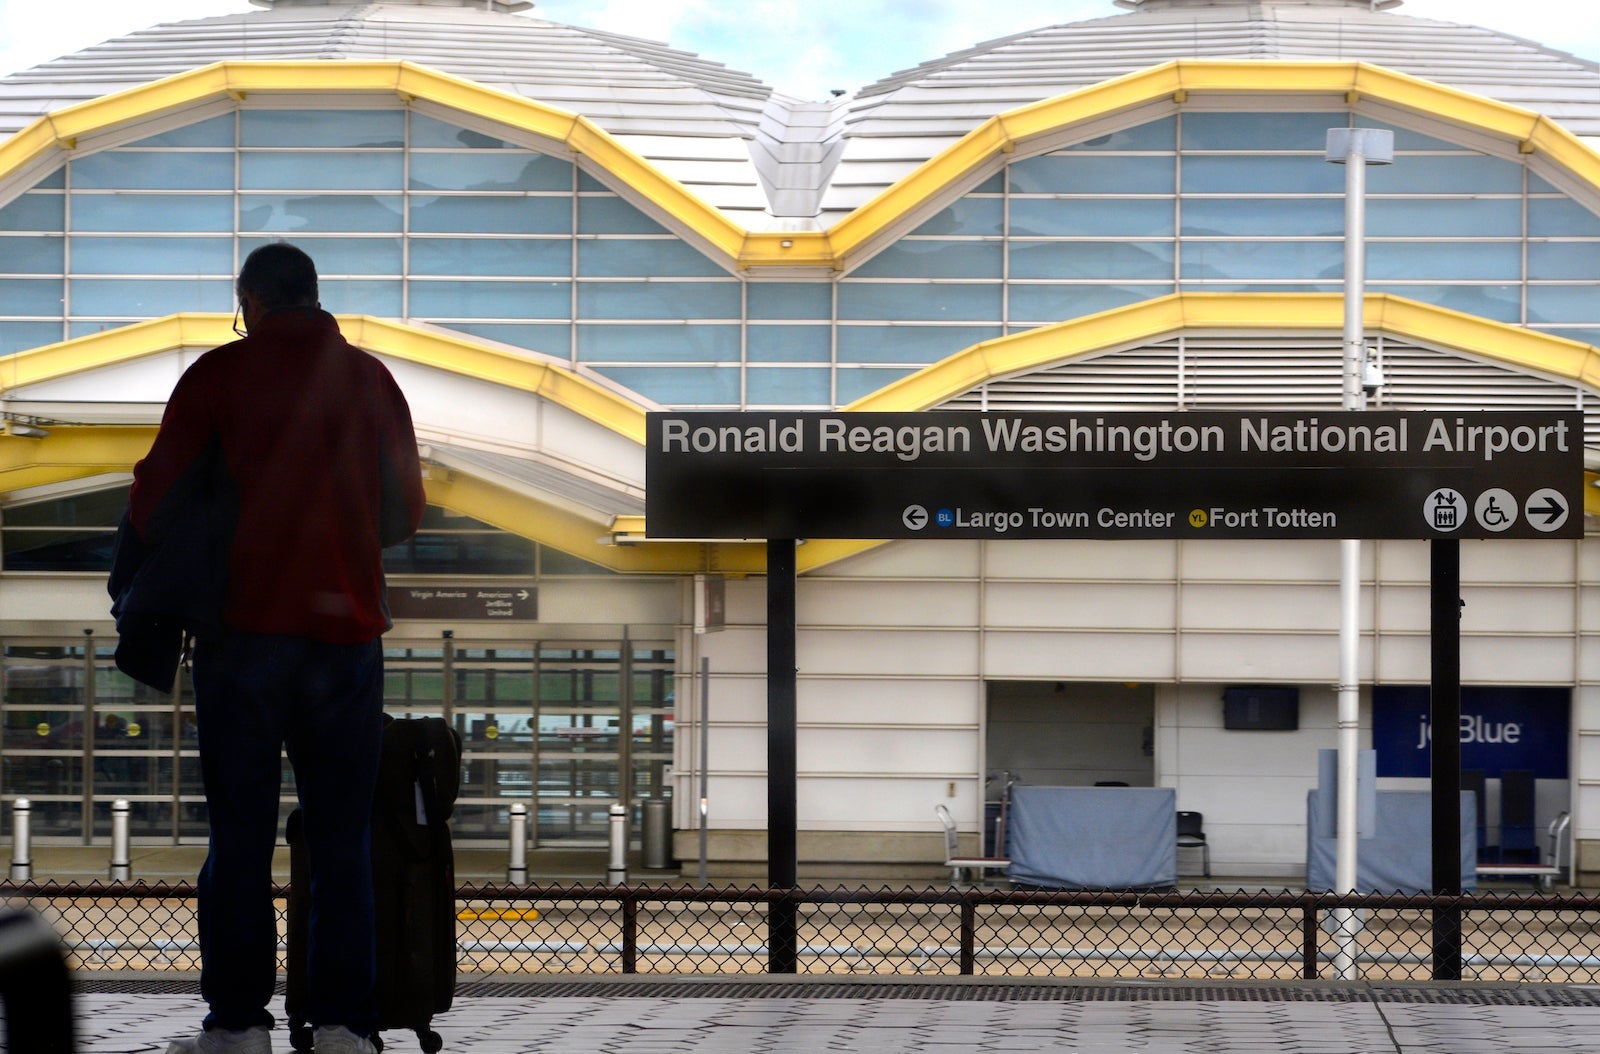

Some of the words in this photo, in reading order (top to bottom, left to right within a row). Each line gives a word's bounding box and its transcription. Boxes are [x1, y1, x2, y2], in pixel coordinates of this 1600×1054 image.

[661, 418, 804, 453] Ronald
[819, 418, 971, 461] Reagan
[980, 417, 1225, 461] Washington
[1240, 417, 1408, 453] National
[1422, 417, 1570, 461] Airport
[938, 513, 952, 522] BL
[956, 507, 1024, 533] Largo
[1027, 508, 1090, 528] Town
[1097, 507, 1176, 528] Center
[1191, 514, 1205, 523] YL
[1210, 507, 1259, 528] Fort
[1262, 507, 1337, 528] Totten
[410, 590, 434, 600] Virgin
[435, 590, 467, 599] America
[476, 590, 513, 599] American
[487, 608, 513, 616] United
[1417, 715, 1522, 749] jBlue
